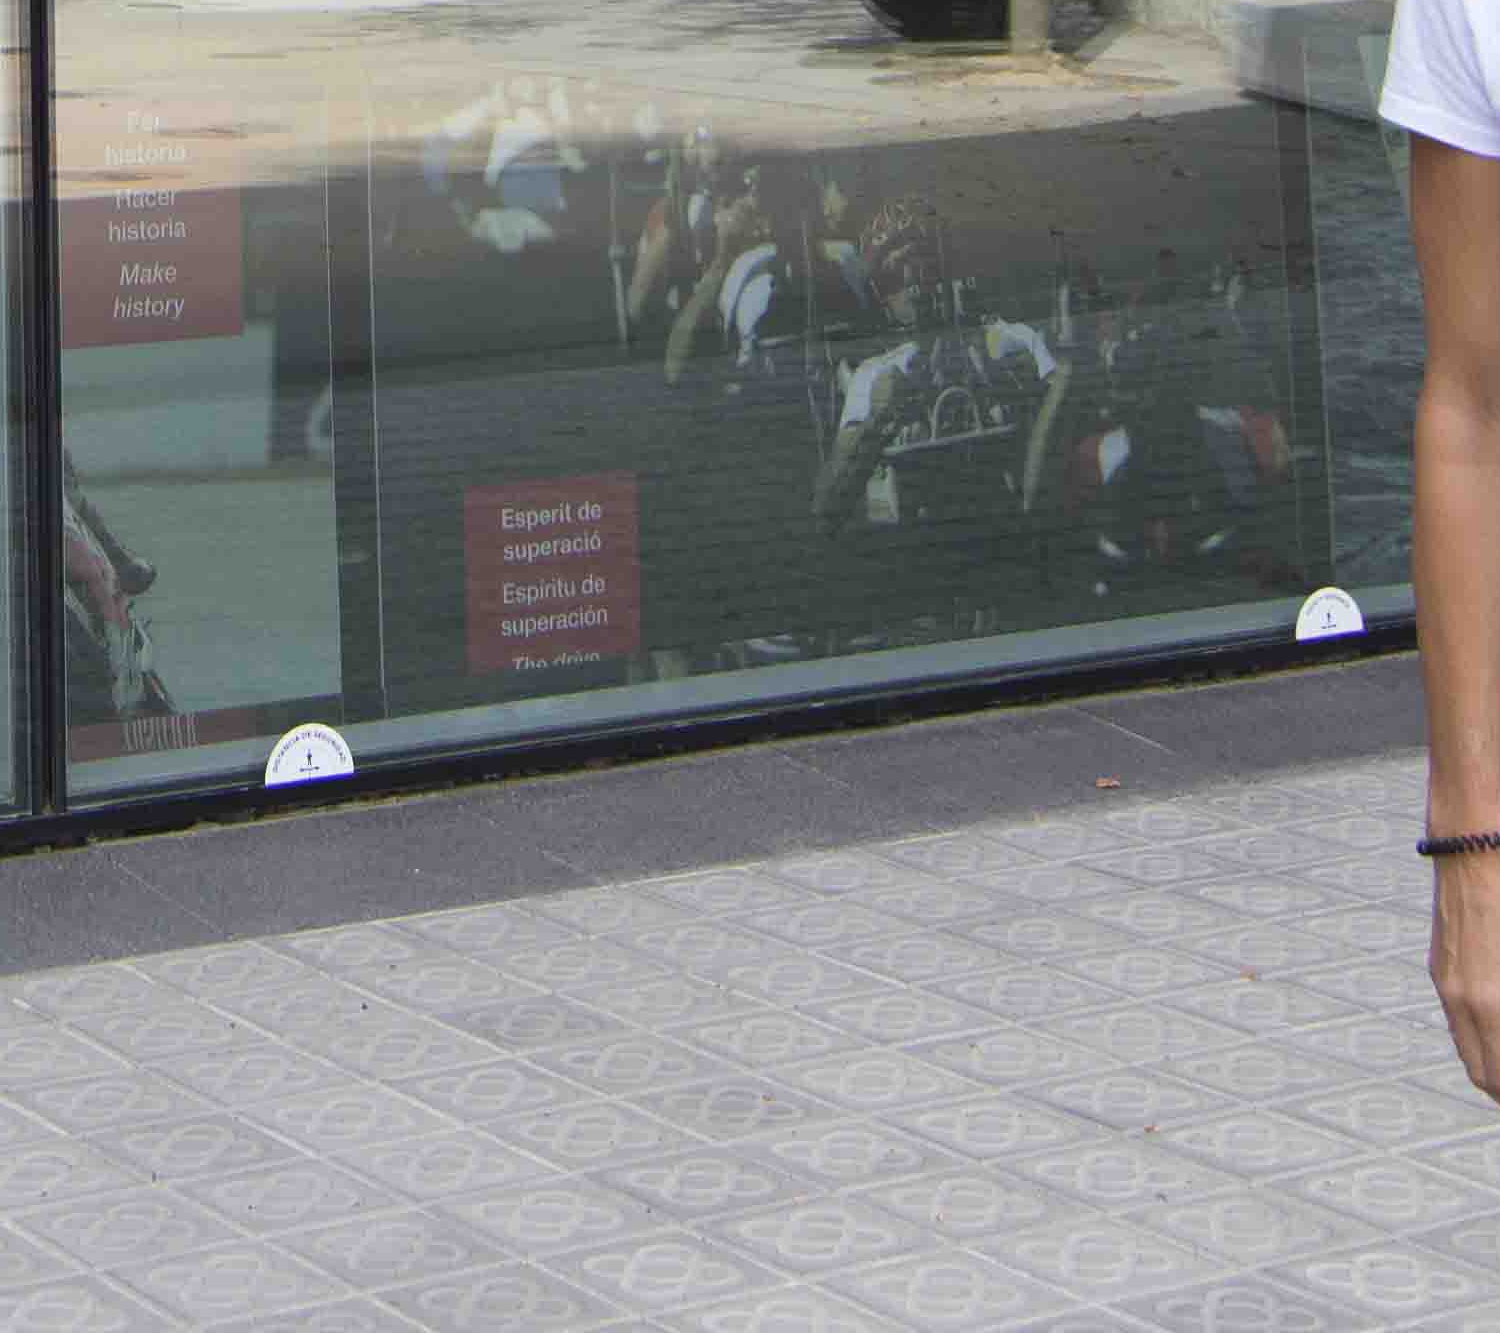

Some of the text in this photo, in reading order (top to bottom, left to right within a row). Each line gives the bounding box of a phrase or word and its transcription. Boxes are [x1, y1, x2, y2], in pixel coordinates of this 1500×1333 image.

[107, 217, 187, 244] historia
[119, 262, 178, 286] Make
[112, 294, 186, 323] history
[501, 500, 603, 532] Esperit de
[503, 531, 602, 563] superació
[580, 574, 606, 596] de
[501, 604, 609, 637] superación
